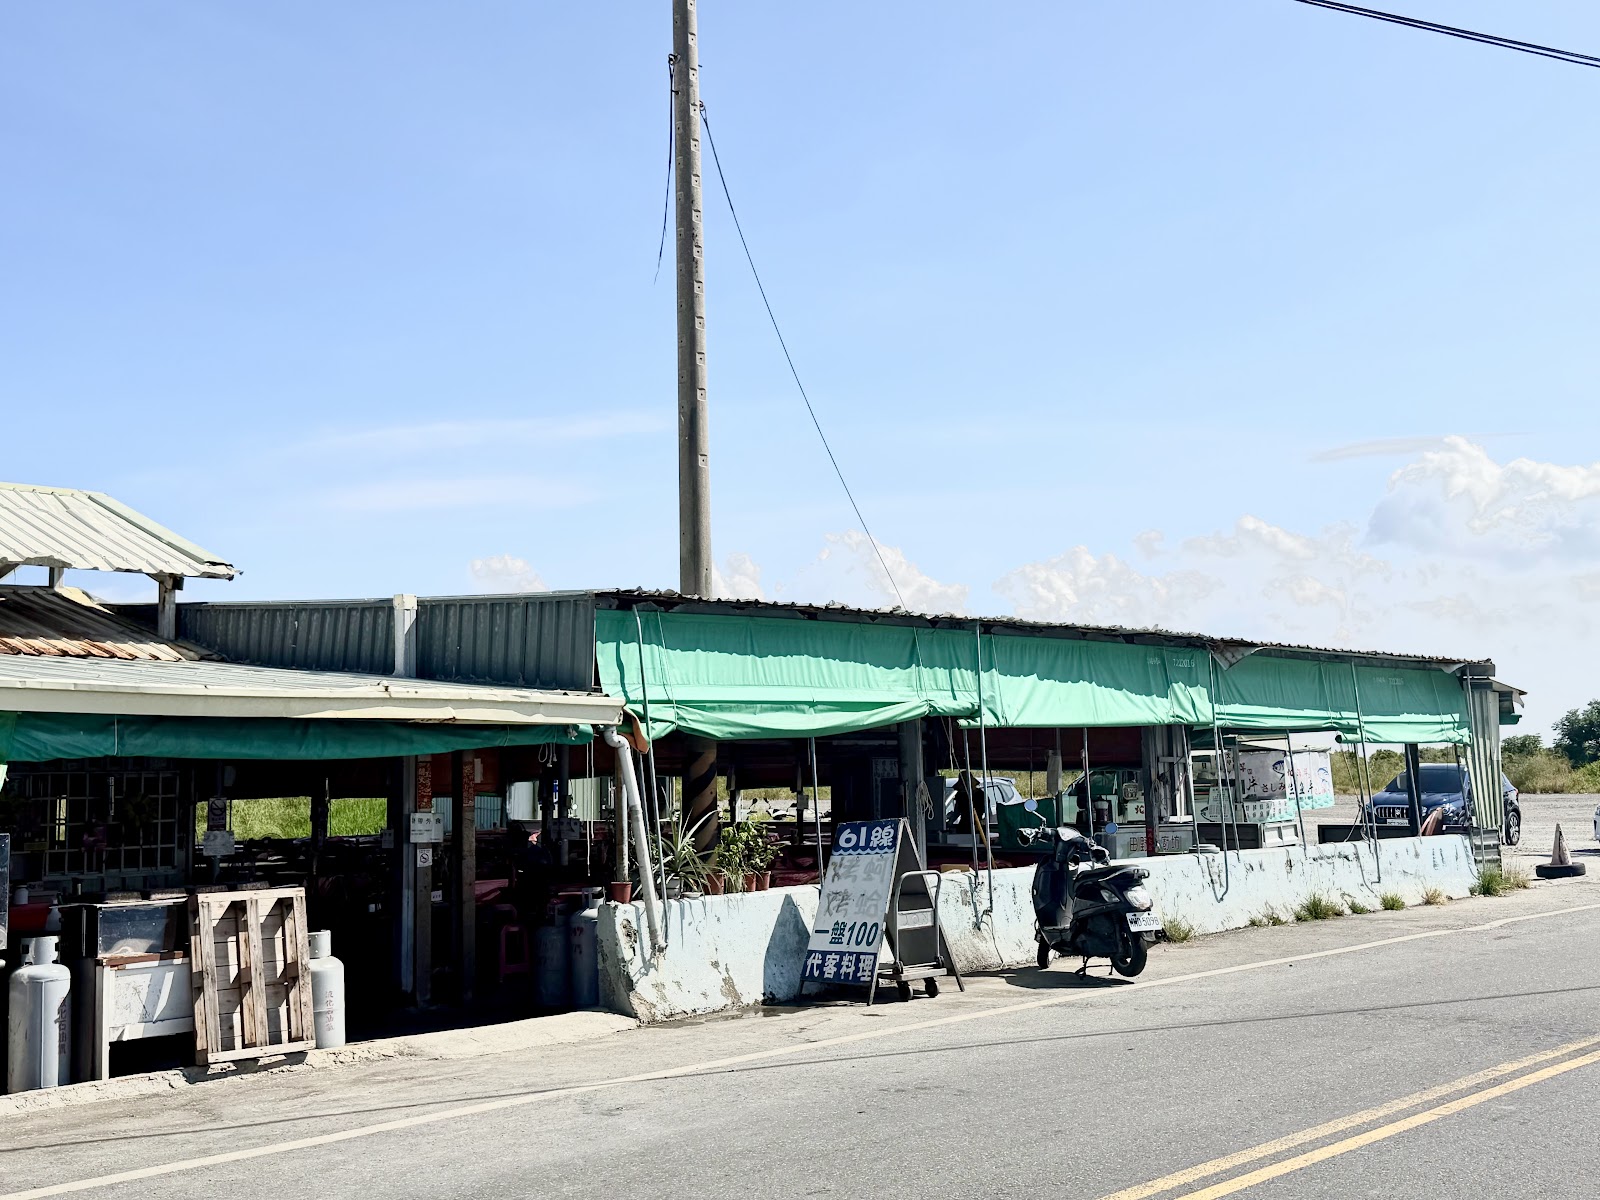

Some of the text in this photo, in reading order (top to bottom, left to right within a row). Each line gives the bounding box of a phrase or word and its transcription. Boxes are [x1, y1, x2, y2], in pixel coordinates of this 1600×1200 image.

[838, 824, 895, 848] 61線
[805, 952, 878, 982] 代客料理
